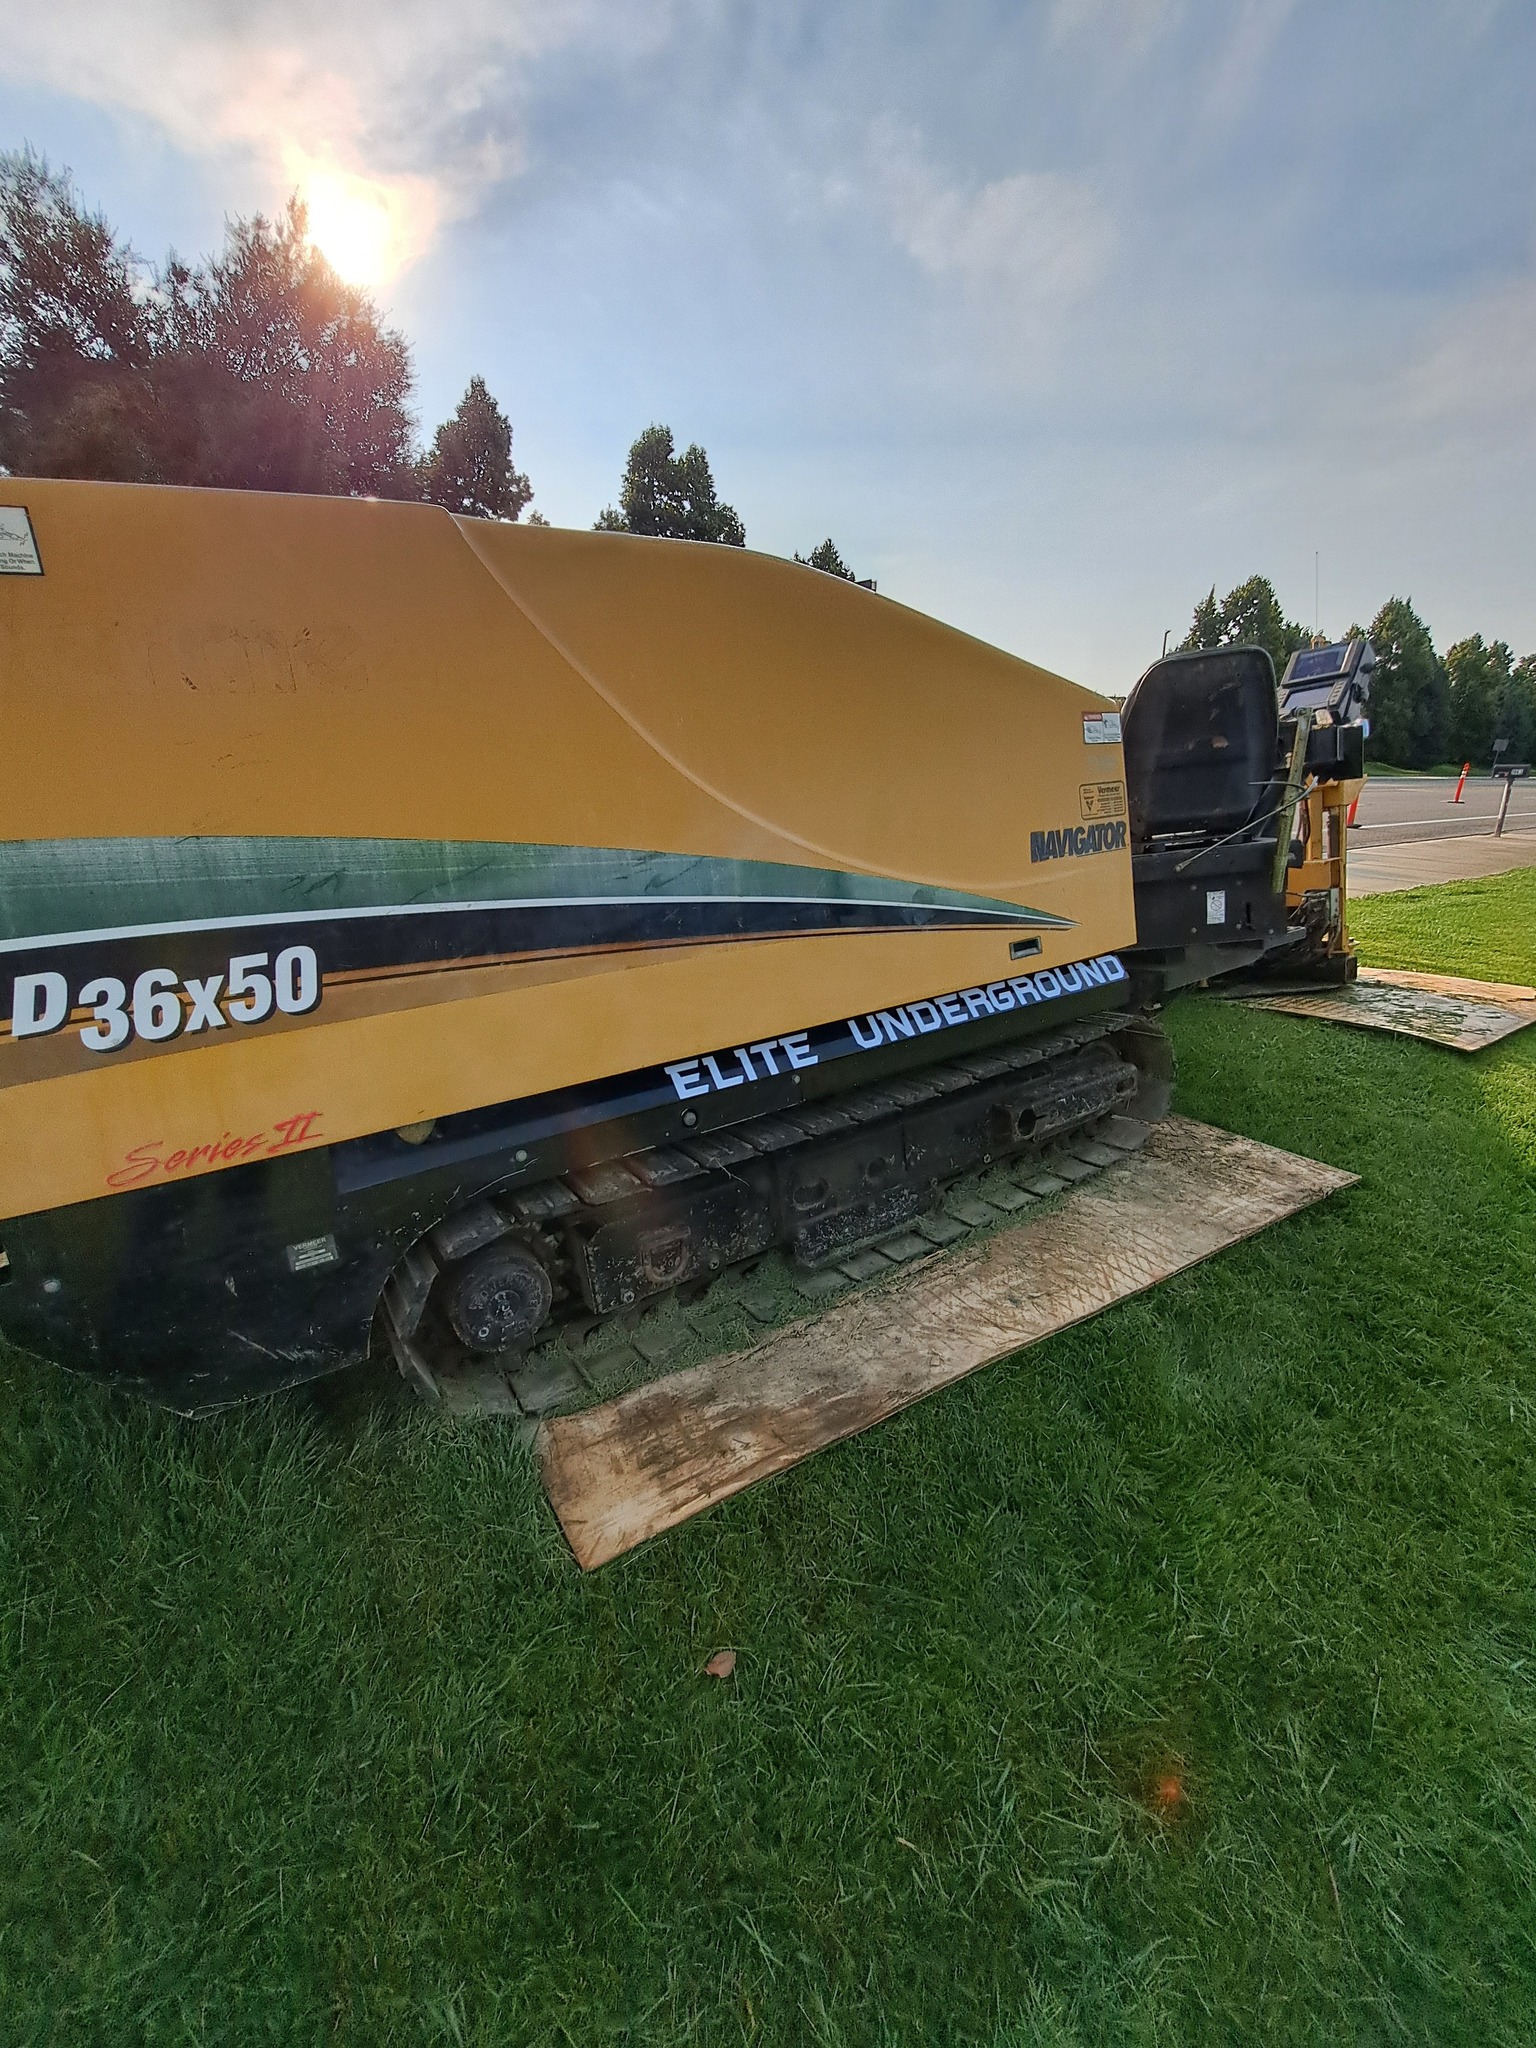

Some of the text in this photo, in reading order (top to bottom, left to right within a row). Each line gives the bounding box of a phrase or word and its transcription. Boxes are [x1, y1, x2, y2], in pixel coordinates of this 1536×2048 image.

[1097, 785, 1121, 794] Vermeer
[1030, 821, 1127, 863] NAVIGATOR
[664, 954, 1126, 1100] ELITE UNDERGROUND
[107, 1111, 324, 1188] Series II
[292, 1237, 327, 1251] VERMEER
